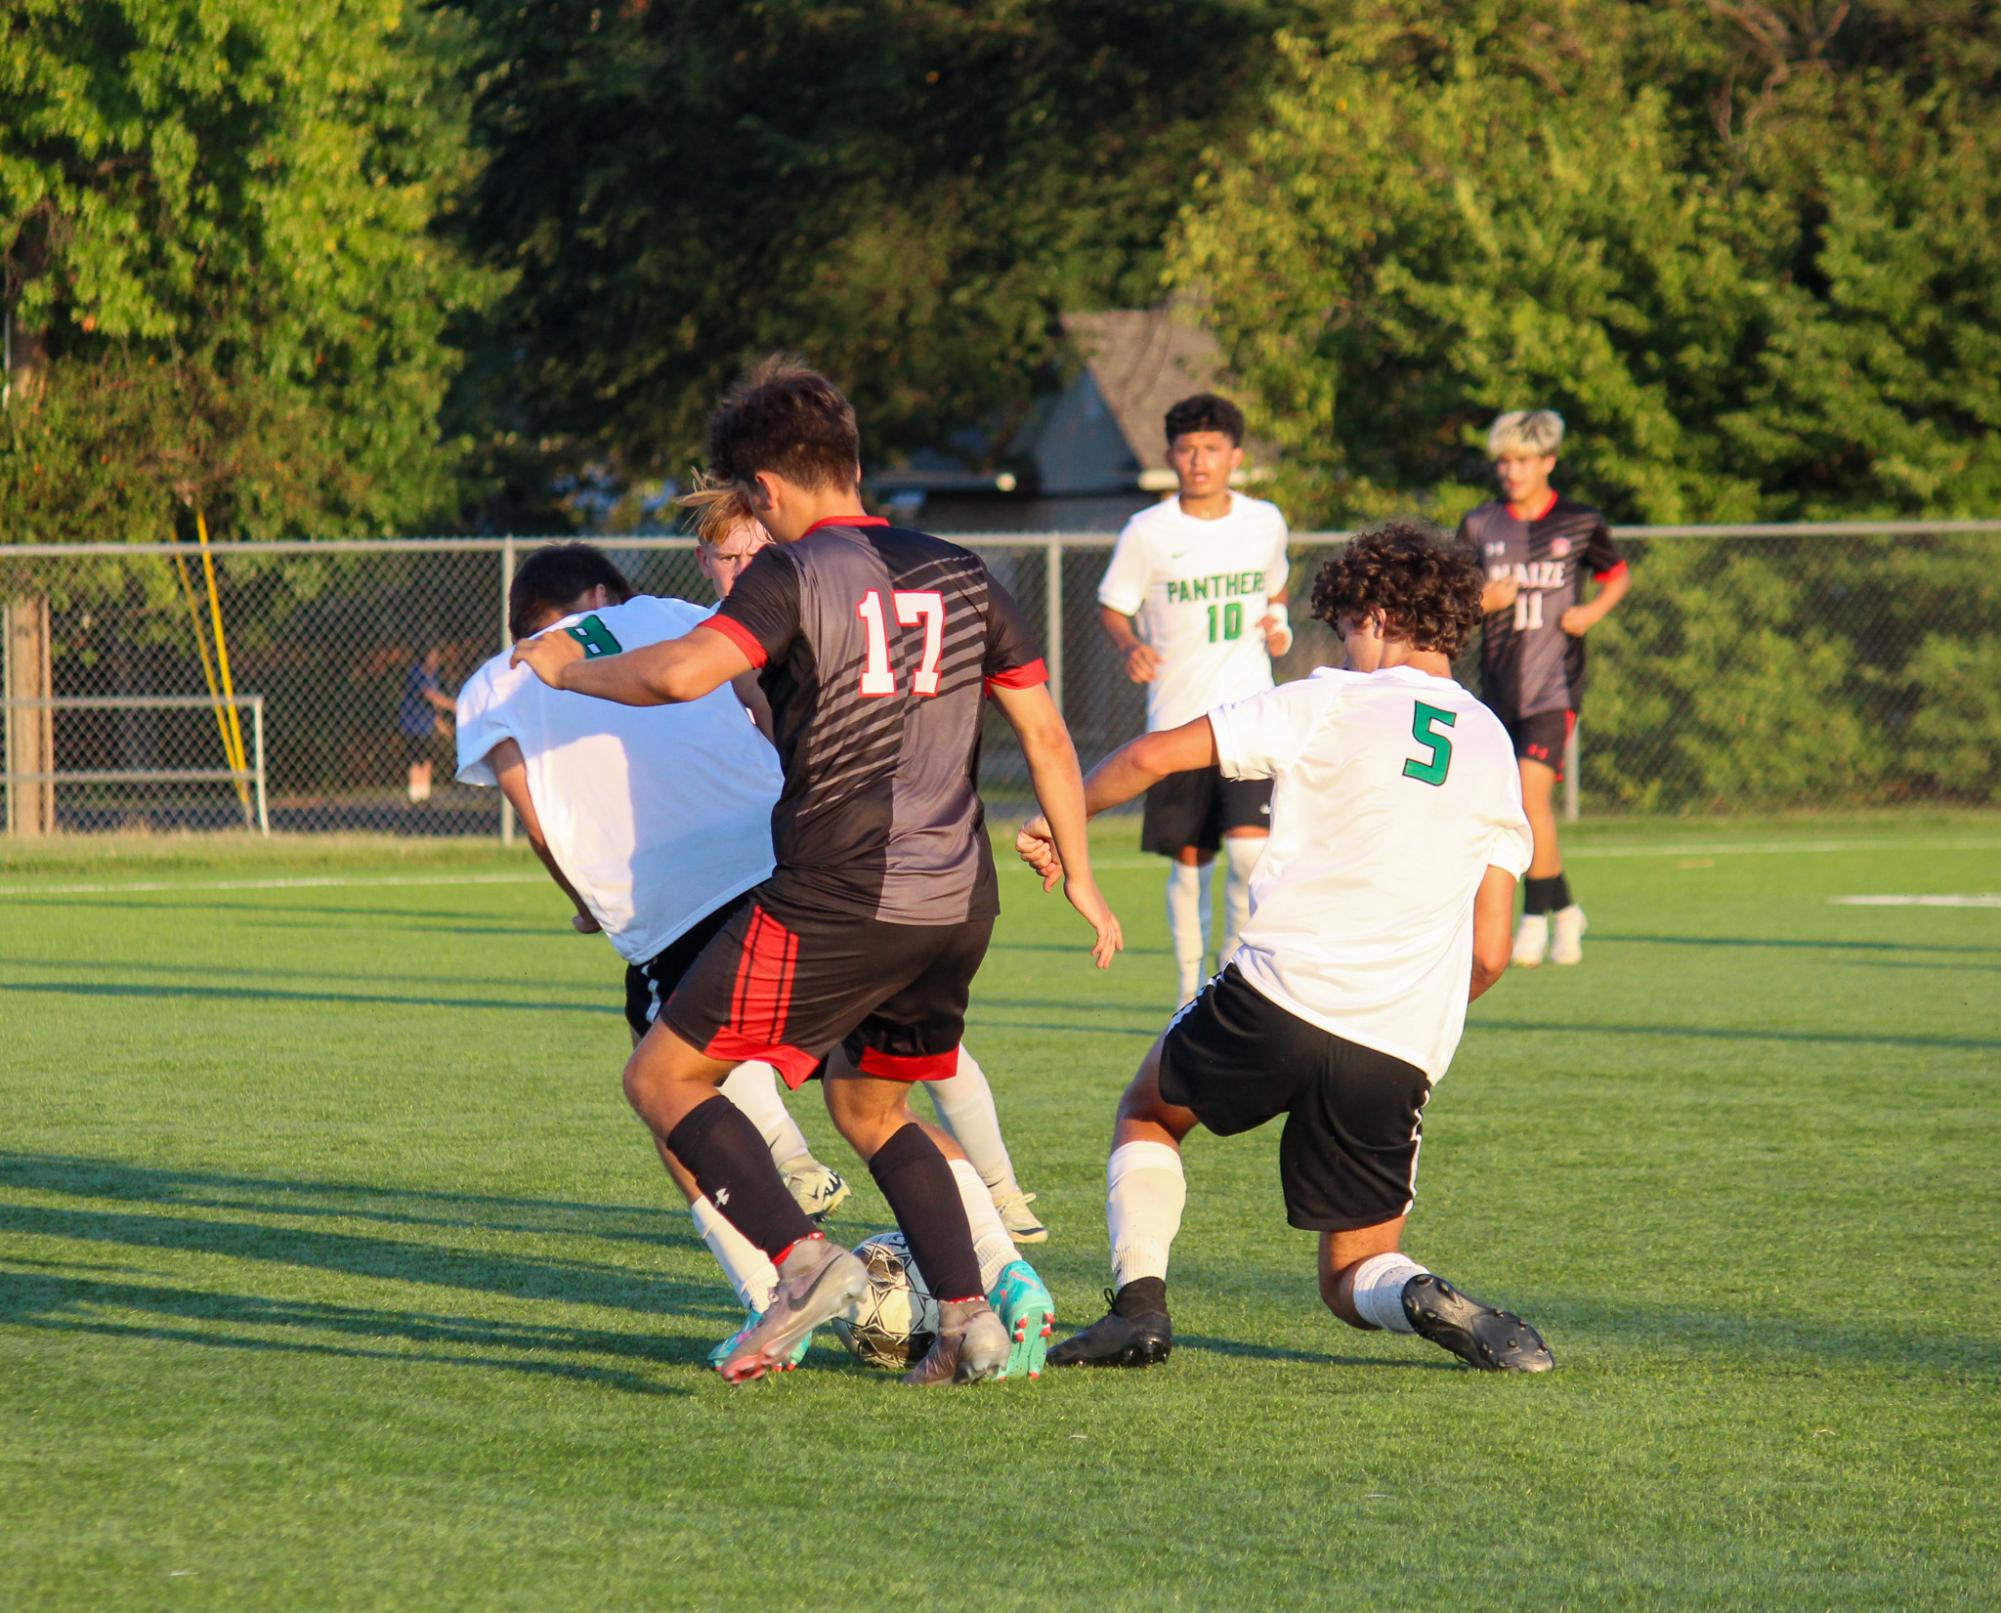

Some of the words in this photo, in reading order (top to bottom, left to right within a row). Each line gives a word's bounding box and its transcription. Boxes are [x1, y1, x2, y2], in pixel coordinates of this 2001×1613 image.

[1208, 602, 1243, 643] 10
[1514, 591, 1543, 631] 11
[564, 614, 623, 660] 8
[855, 588, 946, 698] 17
[1402, 699, 1457, 787] 5
